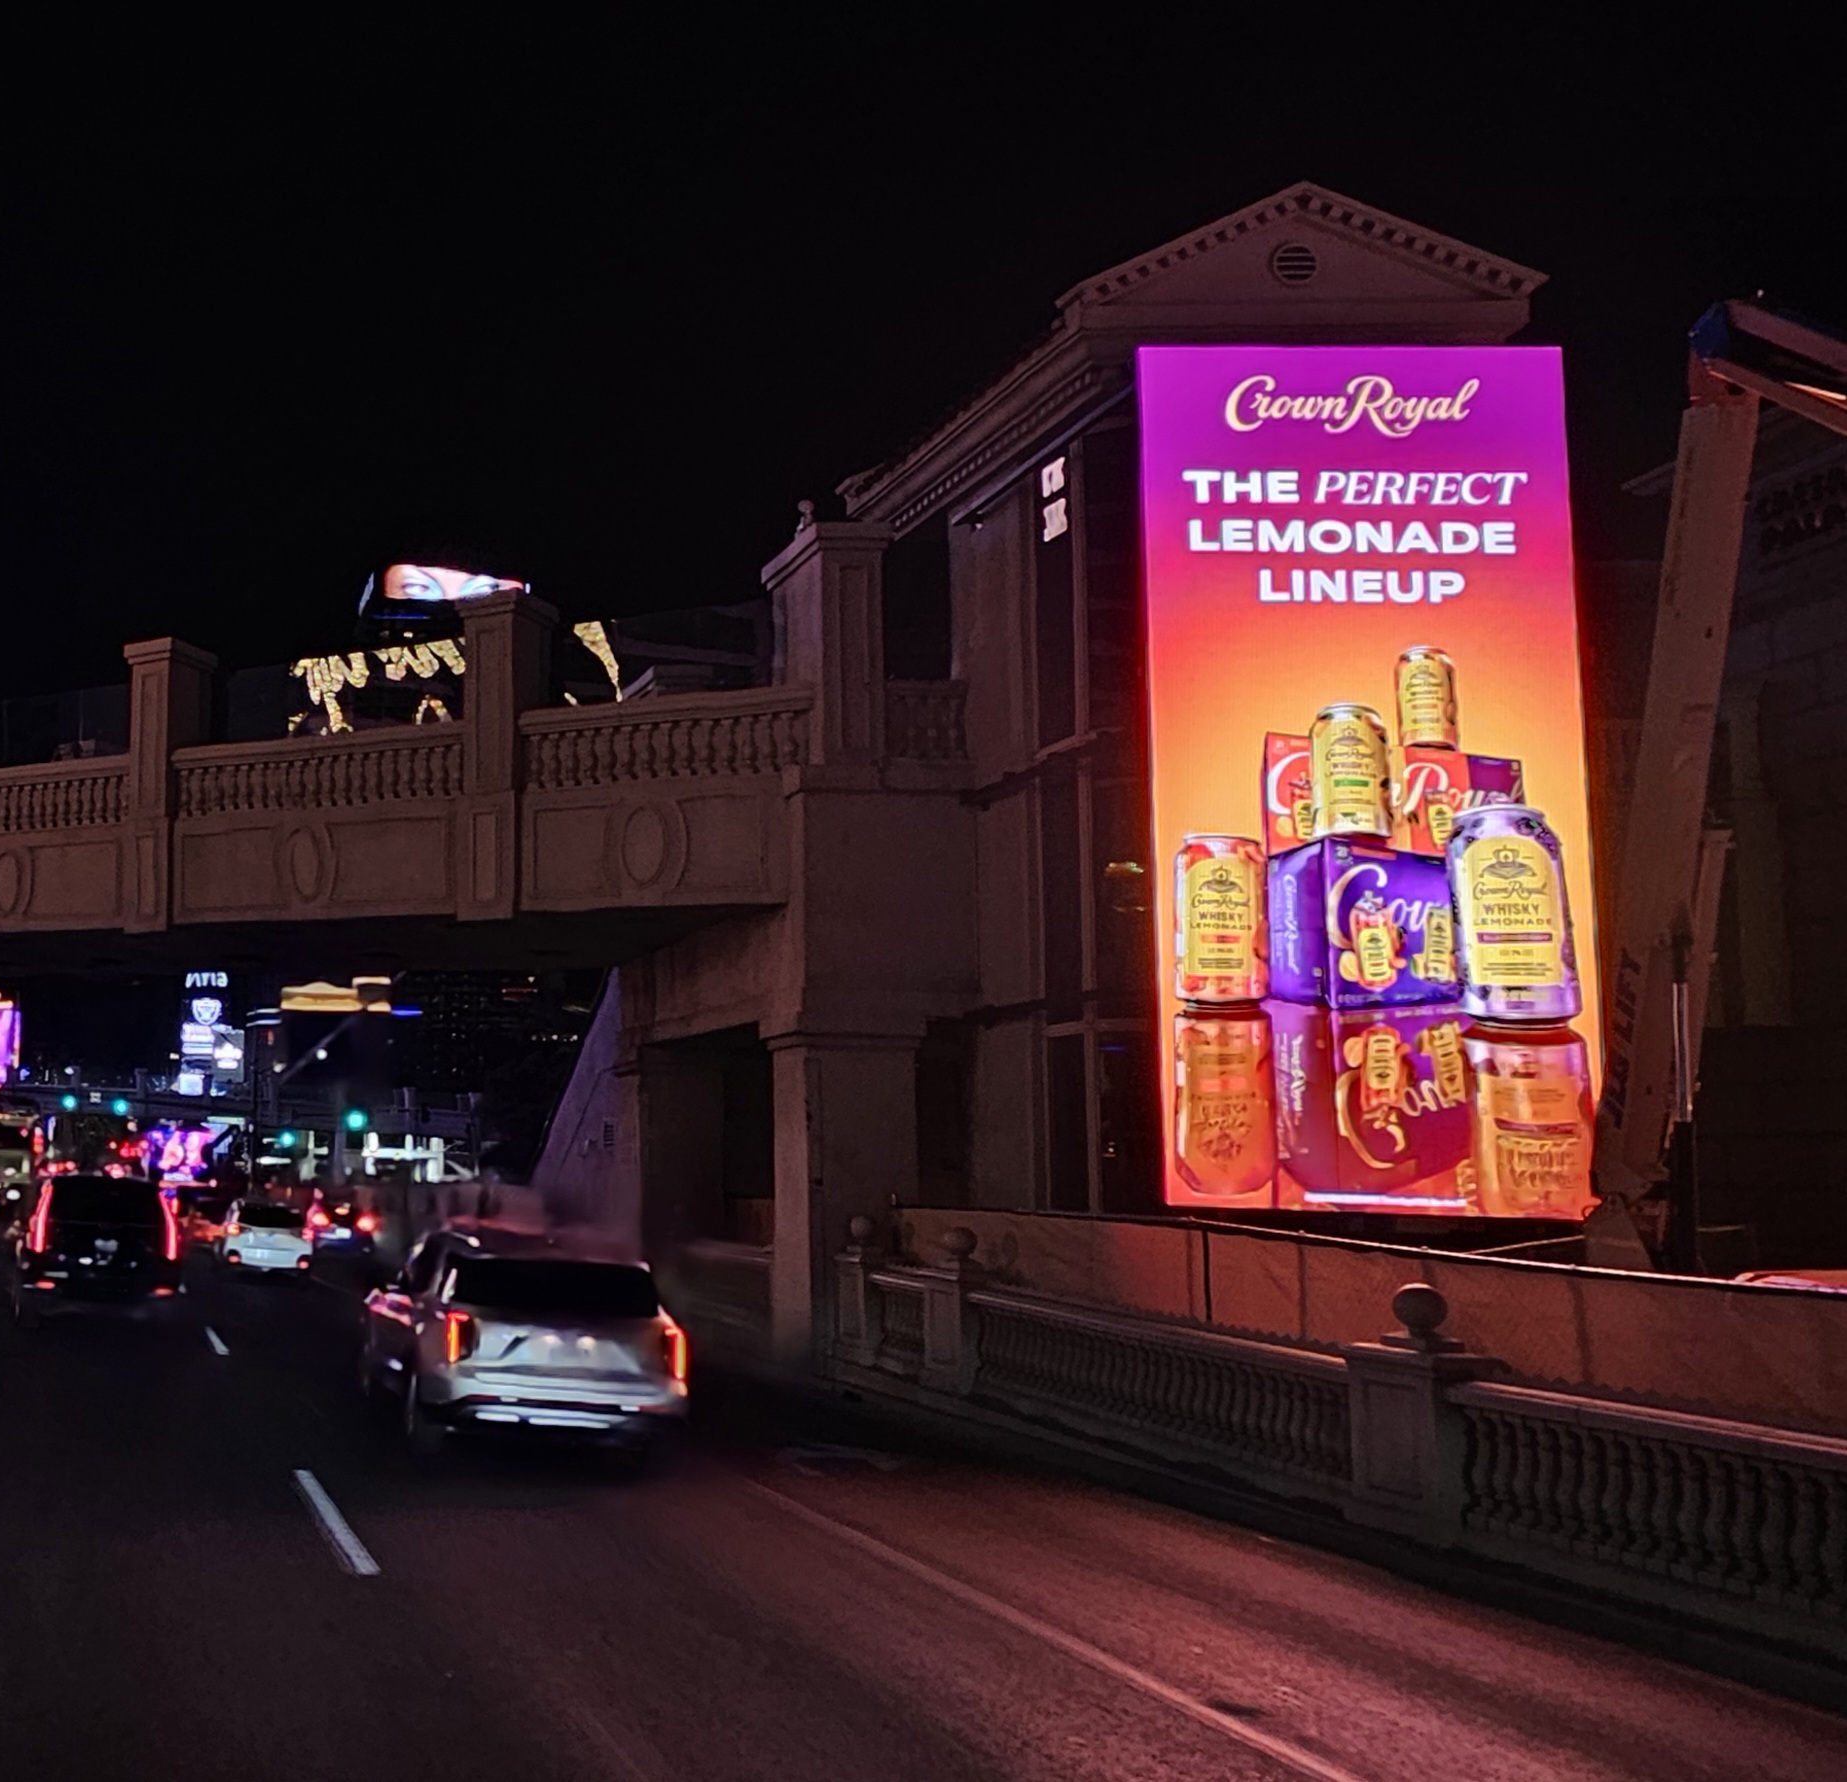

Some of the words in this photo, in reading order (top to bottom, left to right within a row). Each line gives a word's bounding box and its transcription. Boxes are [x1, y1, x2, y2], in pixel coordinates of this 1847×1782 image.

[1224, 374, 1349, 432] Crown
[1326, 374, 1481, 438] Royal
[1182, 469, 1301, 504] THE
[1313, 470, 1528, 506] PERFECT
[1187, 518, 1517, 555] LEMONADE
[1258, 568, 1467, 604] LINEUP
[1482, 902, 1540, 916] WHISKY
